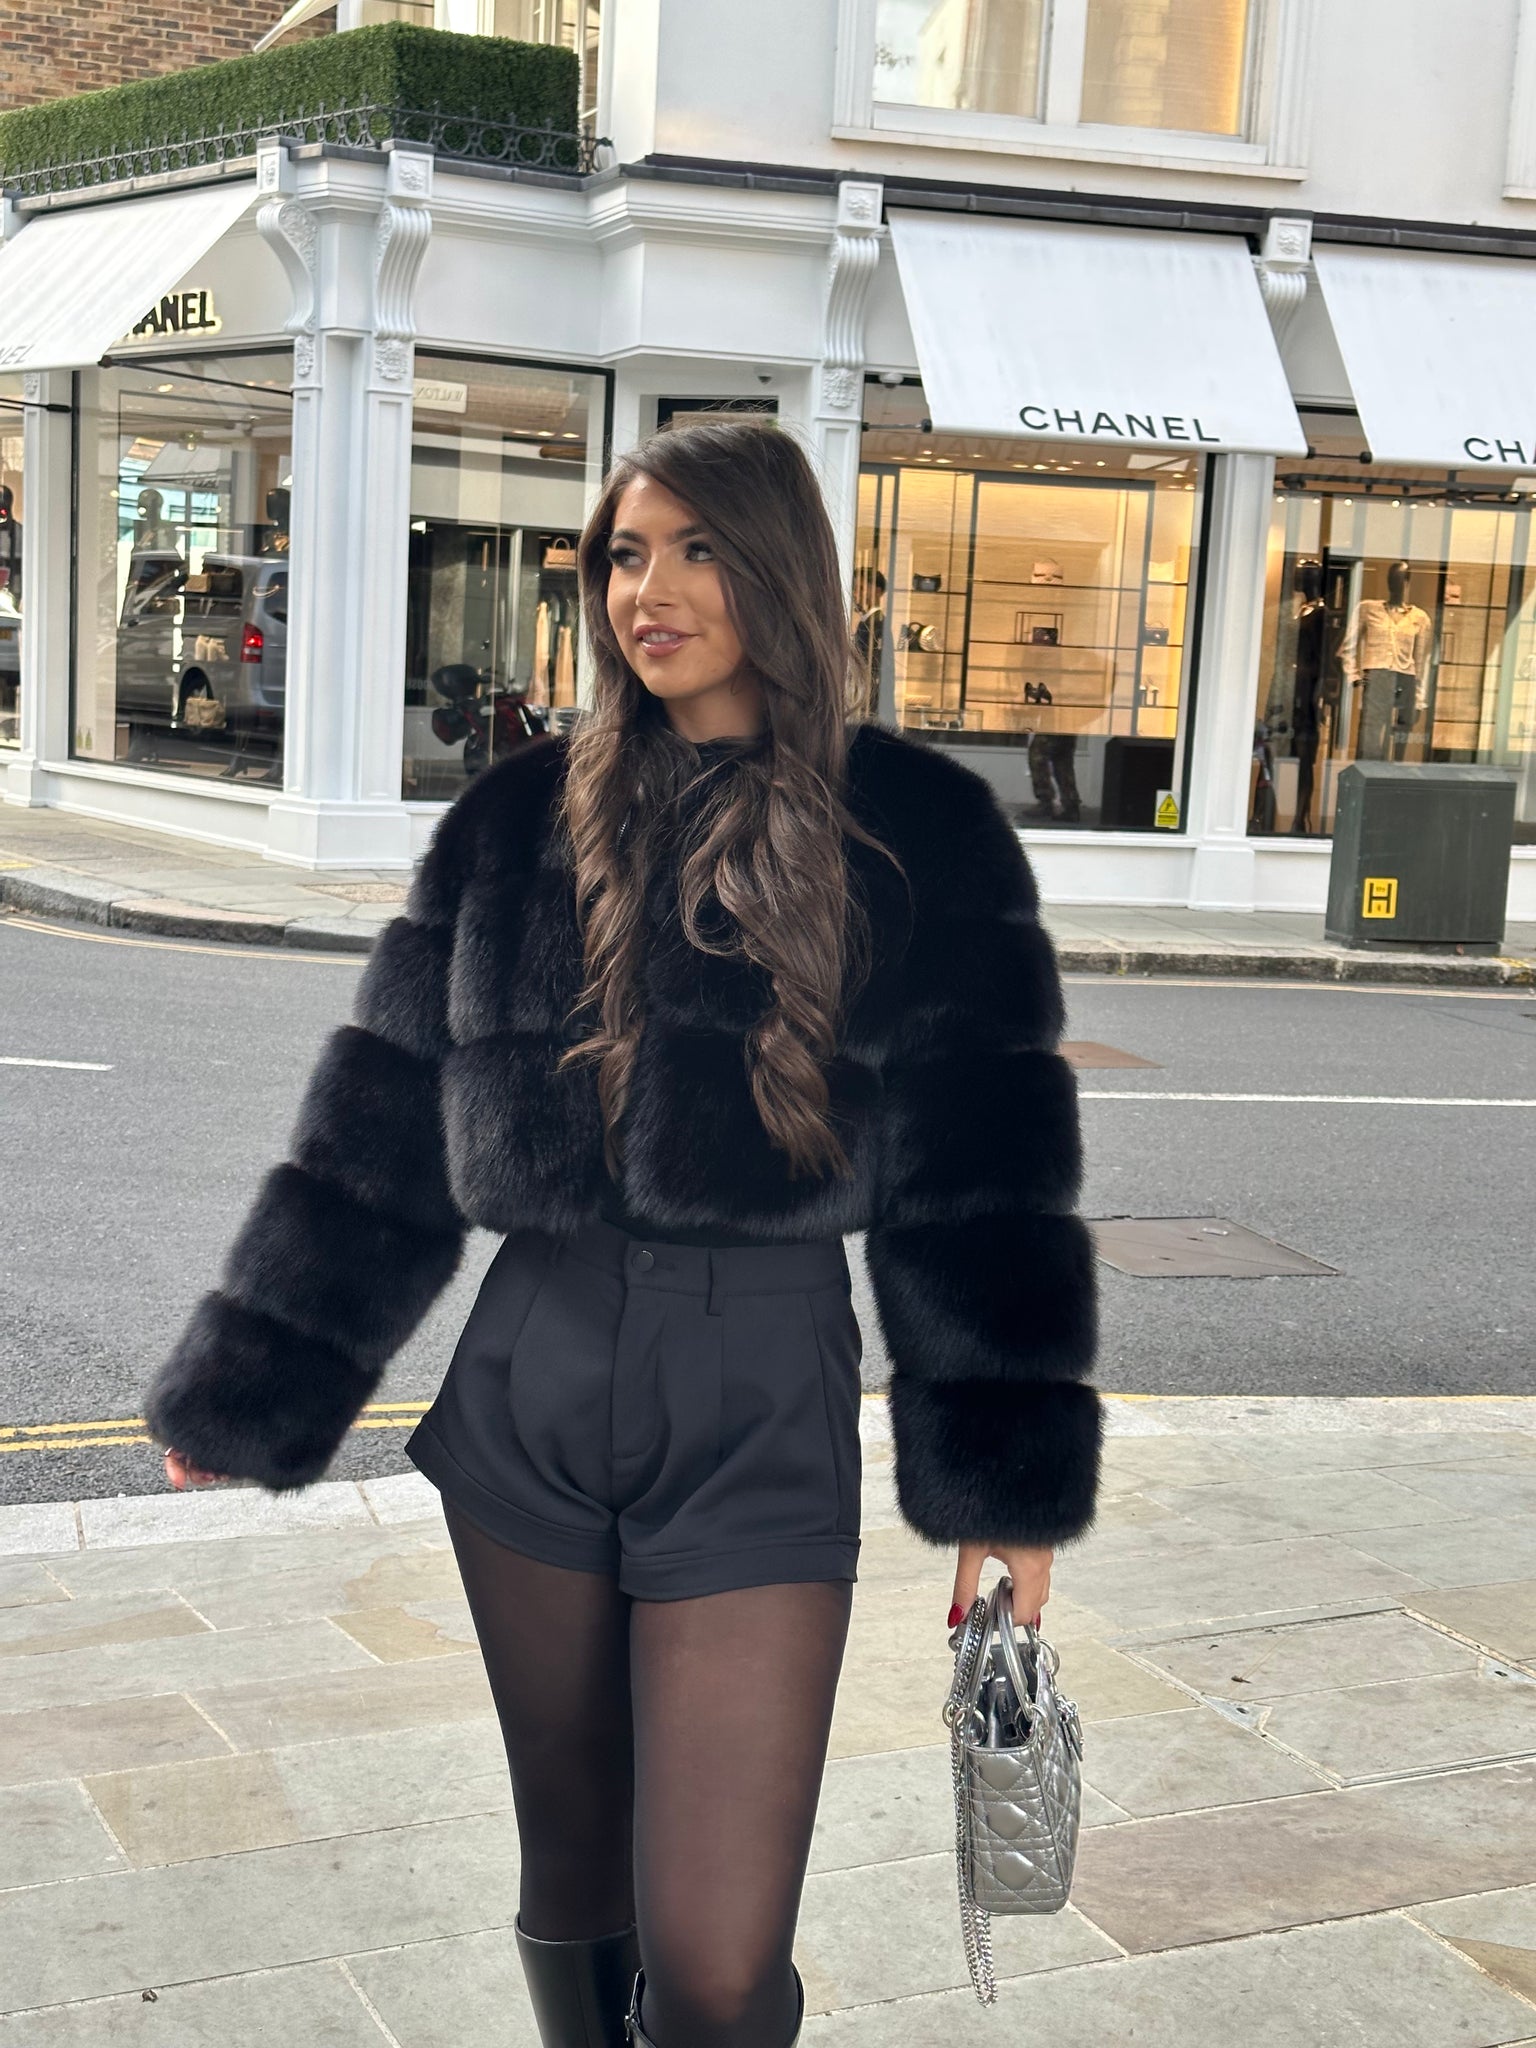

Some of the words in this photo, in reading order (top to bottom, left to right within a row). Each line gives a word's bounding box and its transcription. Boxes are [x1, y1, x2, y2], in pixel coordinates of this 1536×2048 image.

[1019, 406, 1220, 443] CHANEL
[1463, 437, 1536, 464] CH
[1367, 882, 1392, 914] H
